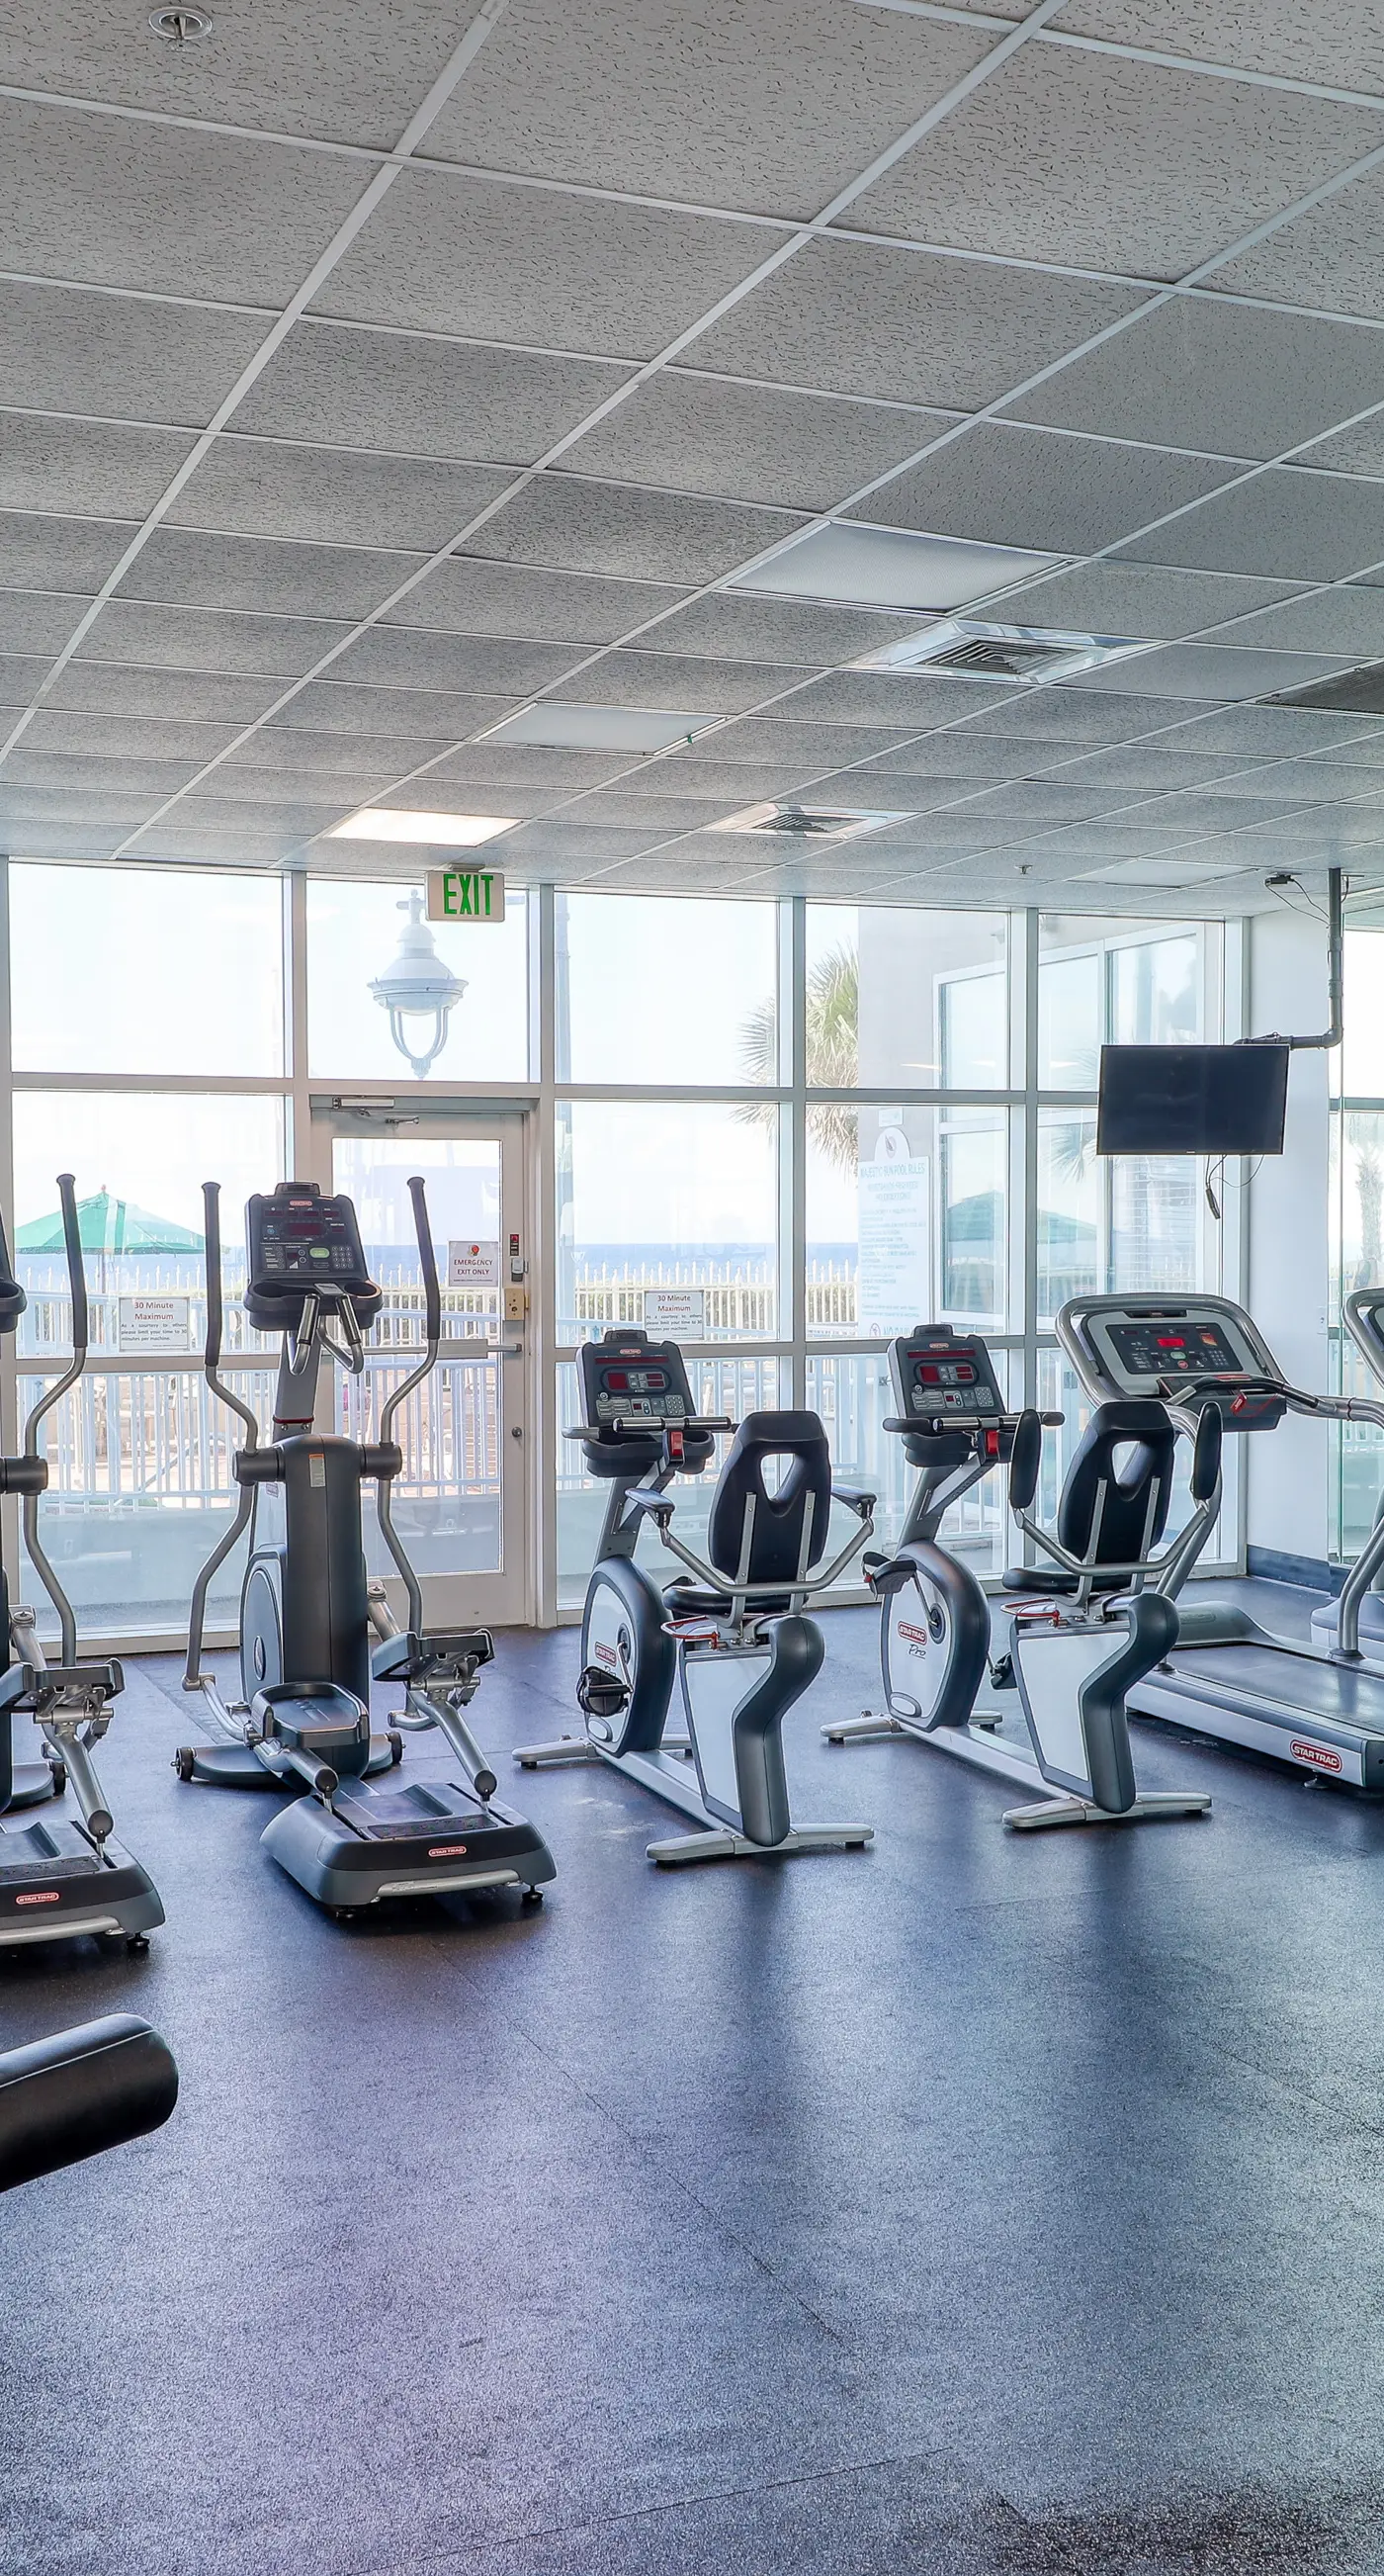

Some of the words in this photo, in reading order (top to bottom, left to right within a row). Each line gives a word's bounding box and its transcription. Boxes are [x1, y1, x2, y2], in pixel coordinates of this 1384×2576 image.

[443, 874, 493, 915] EXIT
[908, 1643, 926, 1656] Pro
[1293, 1745, 1315, 1758] STAR
[1315, 1752, 1338, 1766] TRAC
